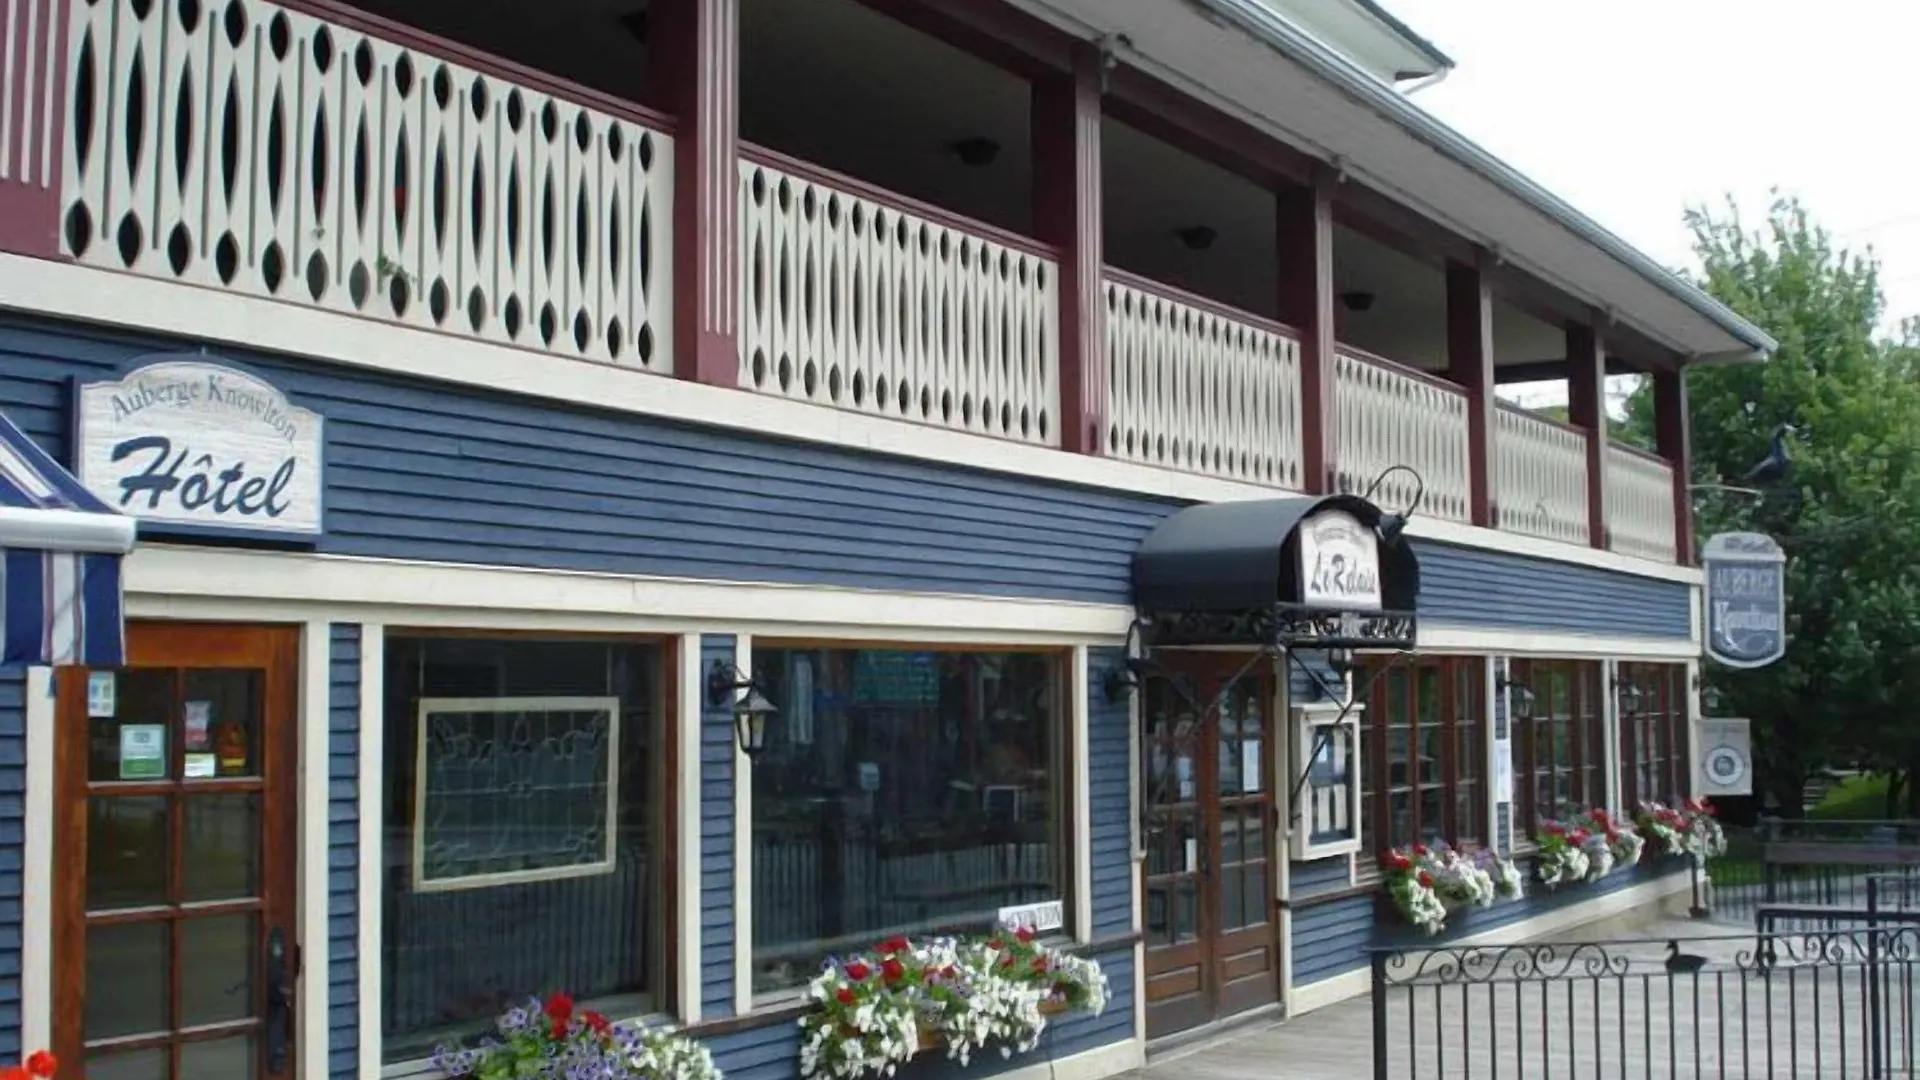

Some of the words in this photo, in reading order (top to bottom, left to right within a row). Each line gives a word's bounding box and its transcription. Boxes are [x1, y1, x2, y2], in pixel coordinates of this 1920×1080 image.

[111, 379, 200, 422] Auberge
[207, 375, 297, 442] Knowlton
[111, 436, 295, 517] Hôtel
